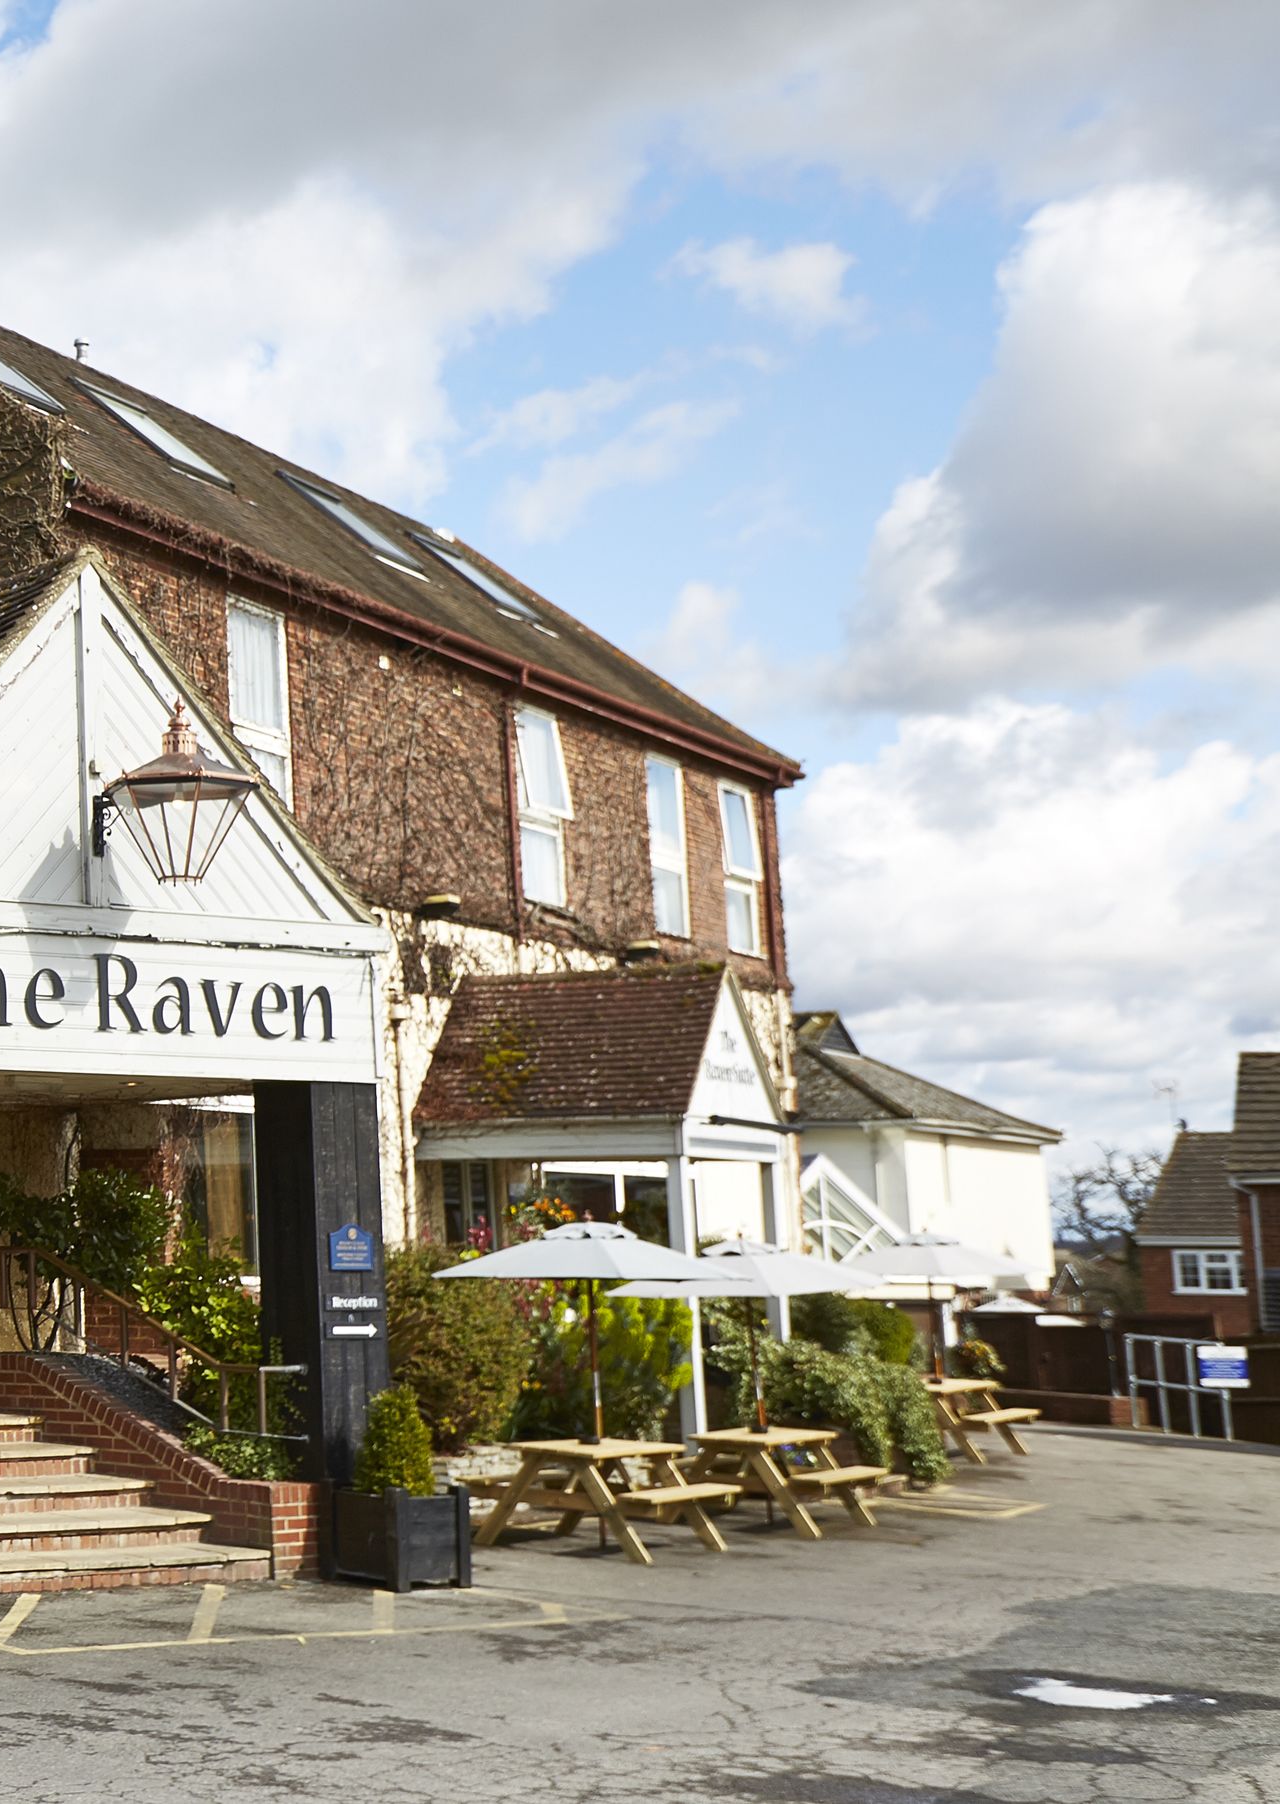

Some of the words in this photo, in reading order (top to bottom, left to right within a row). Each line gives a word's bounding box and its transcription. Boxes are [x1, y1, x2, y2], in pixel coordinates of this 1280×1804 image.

[92, 953, 336, 1043] Raven
[720, 1030, 736, 1053] The
[332, 1296, 378, 1310] Reception
